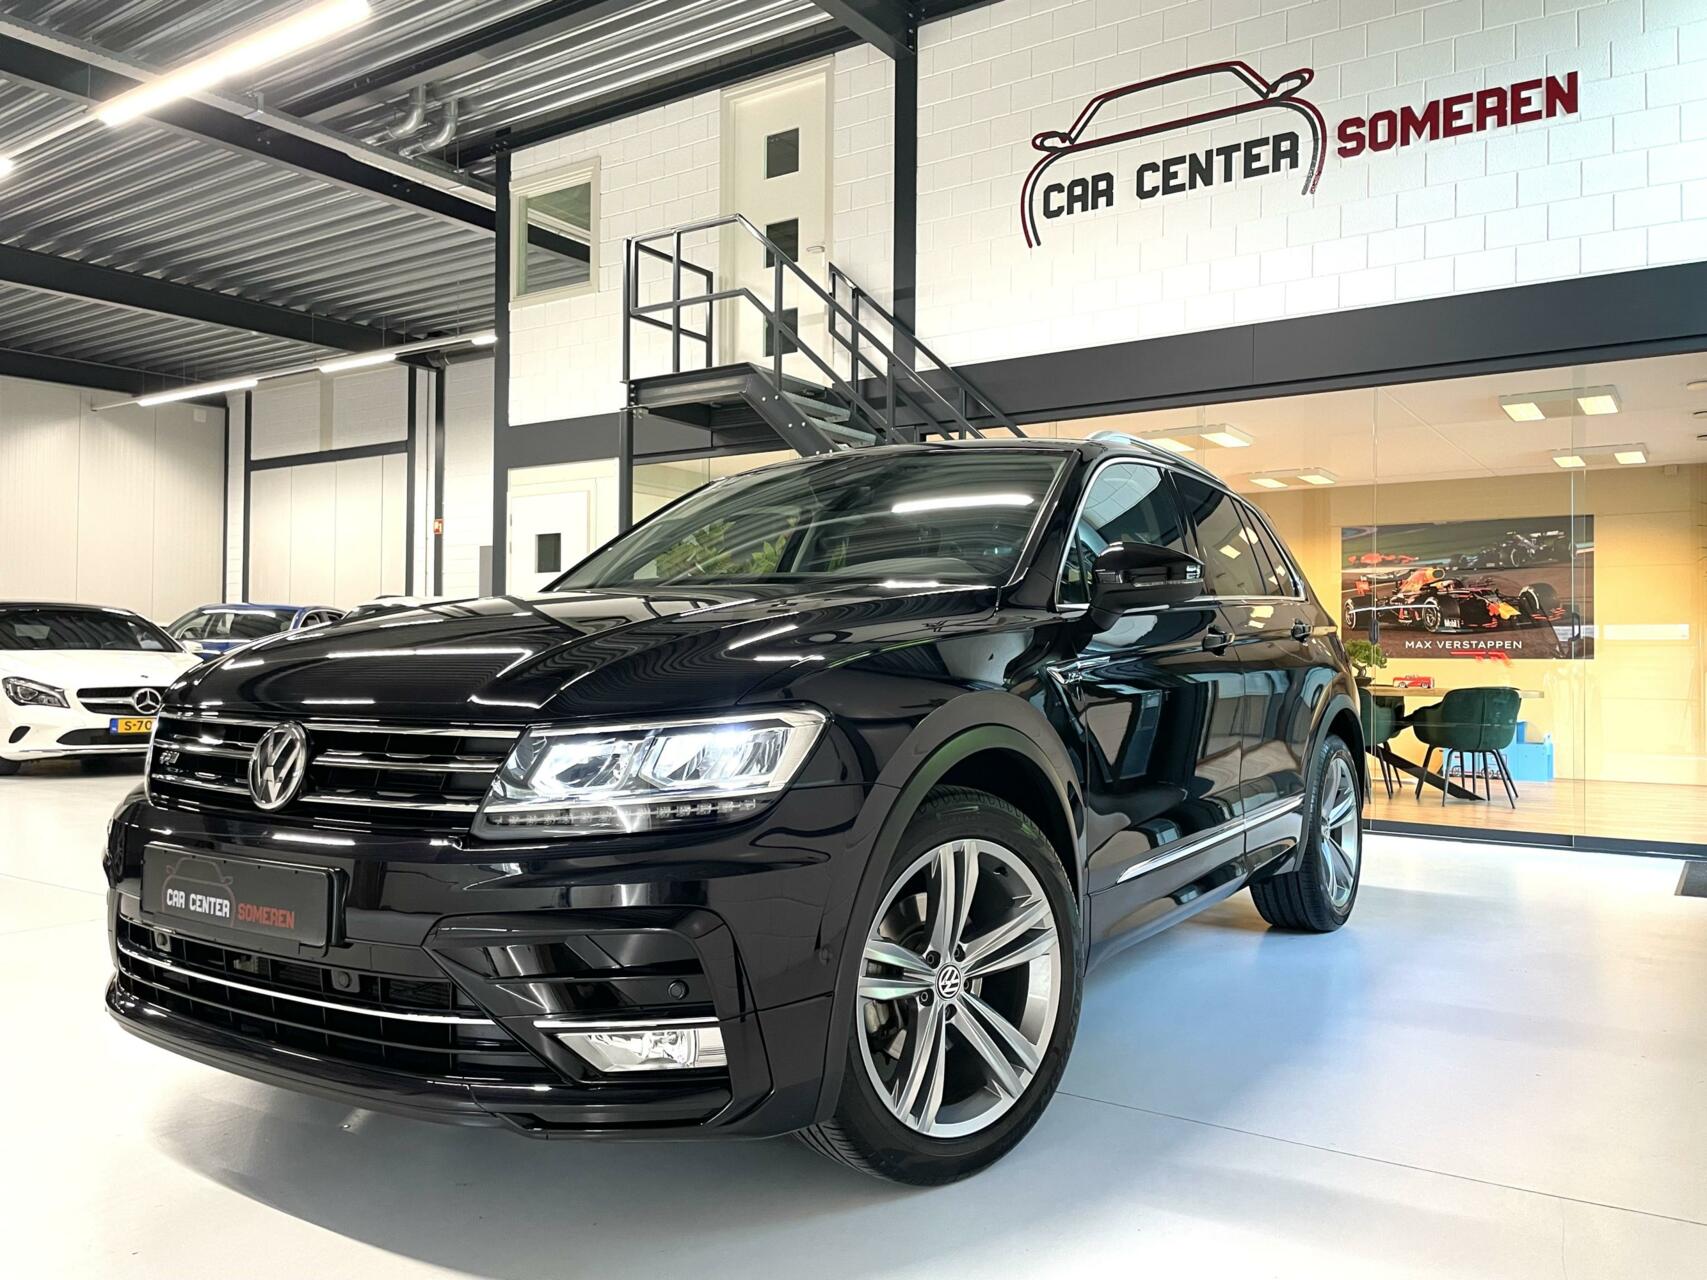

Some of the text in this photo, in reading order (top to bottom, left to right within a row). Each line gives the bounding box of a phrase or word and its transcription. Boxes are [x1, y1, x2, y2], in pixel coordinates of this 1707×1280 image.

[1042, 71, 1579, 220] CAR CENTER SOMEREN
[1405, 640, 1522, 649] MAX VERSTAPPEN
[166, 888, 295, 929] CAR CENTER SOMEREN
